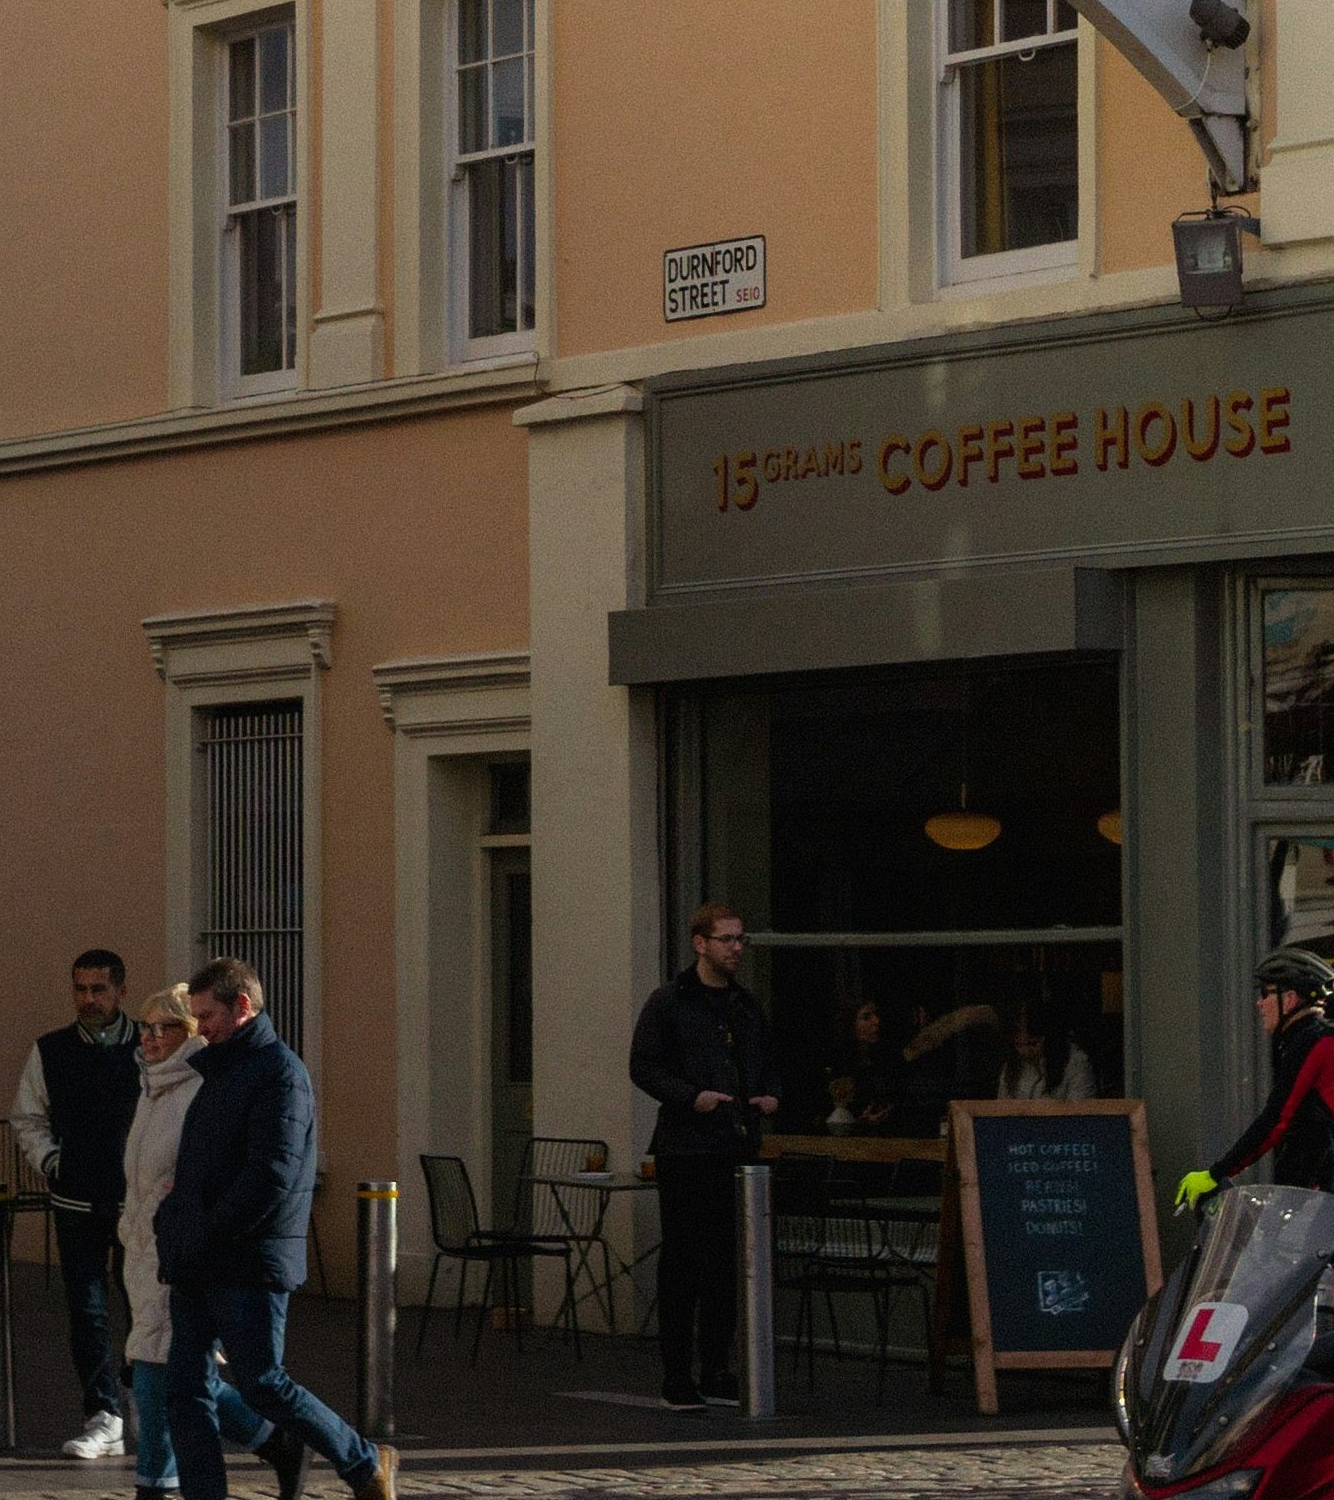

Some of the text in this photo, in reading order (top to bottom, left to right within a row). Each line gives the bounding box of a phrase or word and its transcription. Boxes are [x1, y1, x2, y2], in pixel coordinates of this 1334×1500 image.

[667, 244, 758, 284] DURNFORD
[668, 278, 761, 313] STREET SE10
[876, 409, 1080, 497] COFFEE
[1092, 385, 1293, 472] HOUSE
[1176, 1308, 1223, 1363] L
